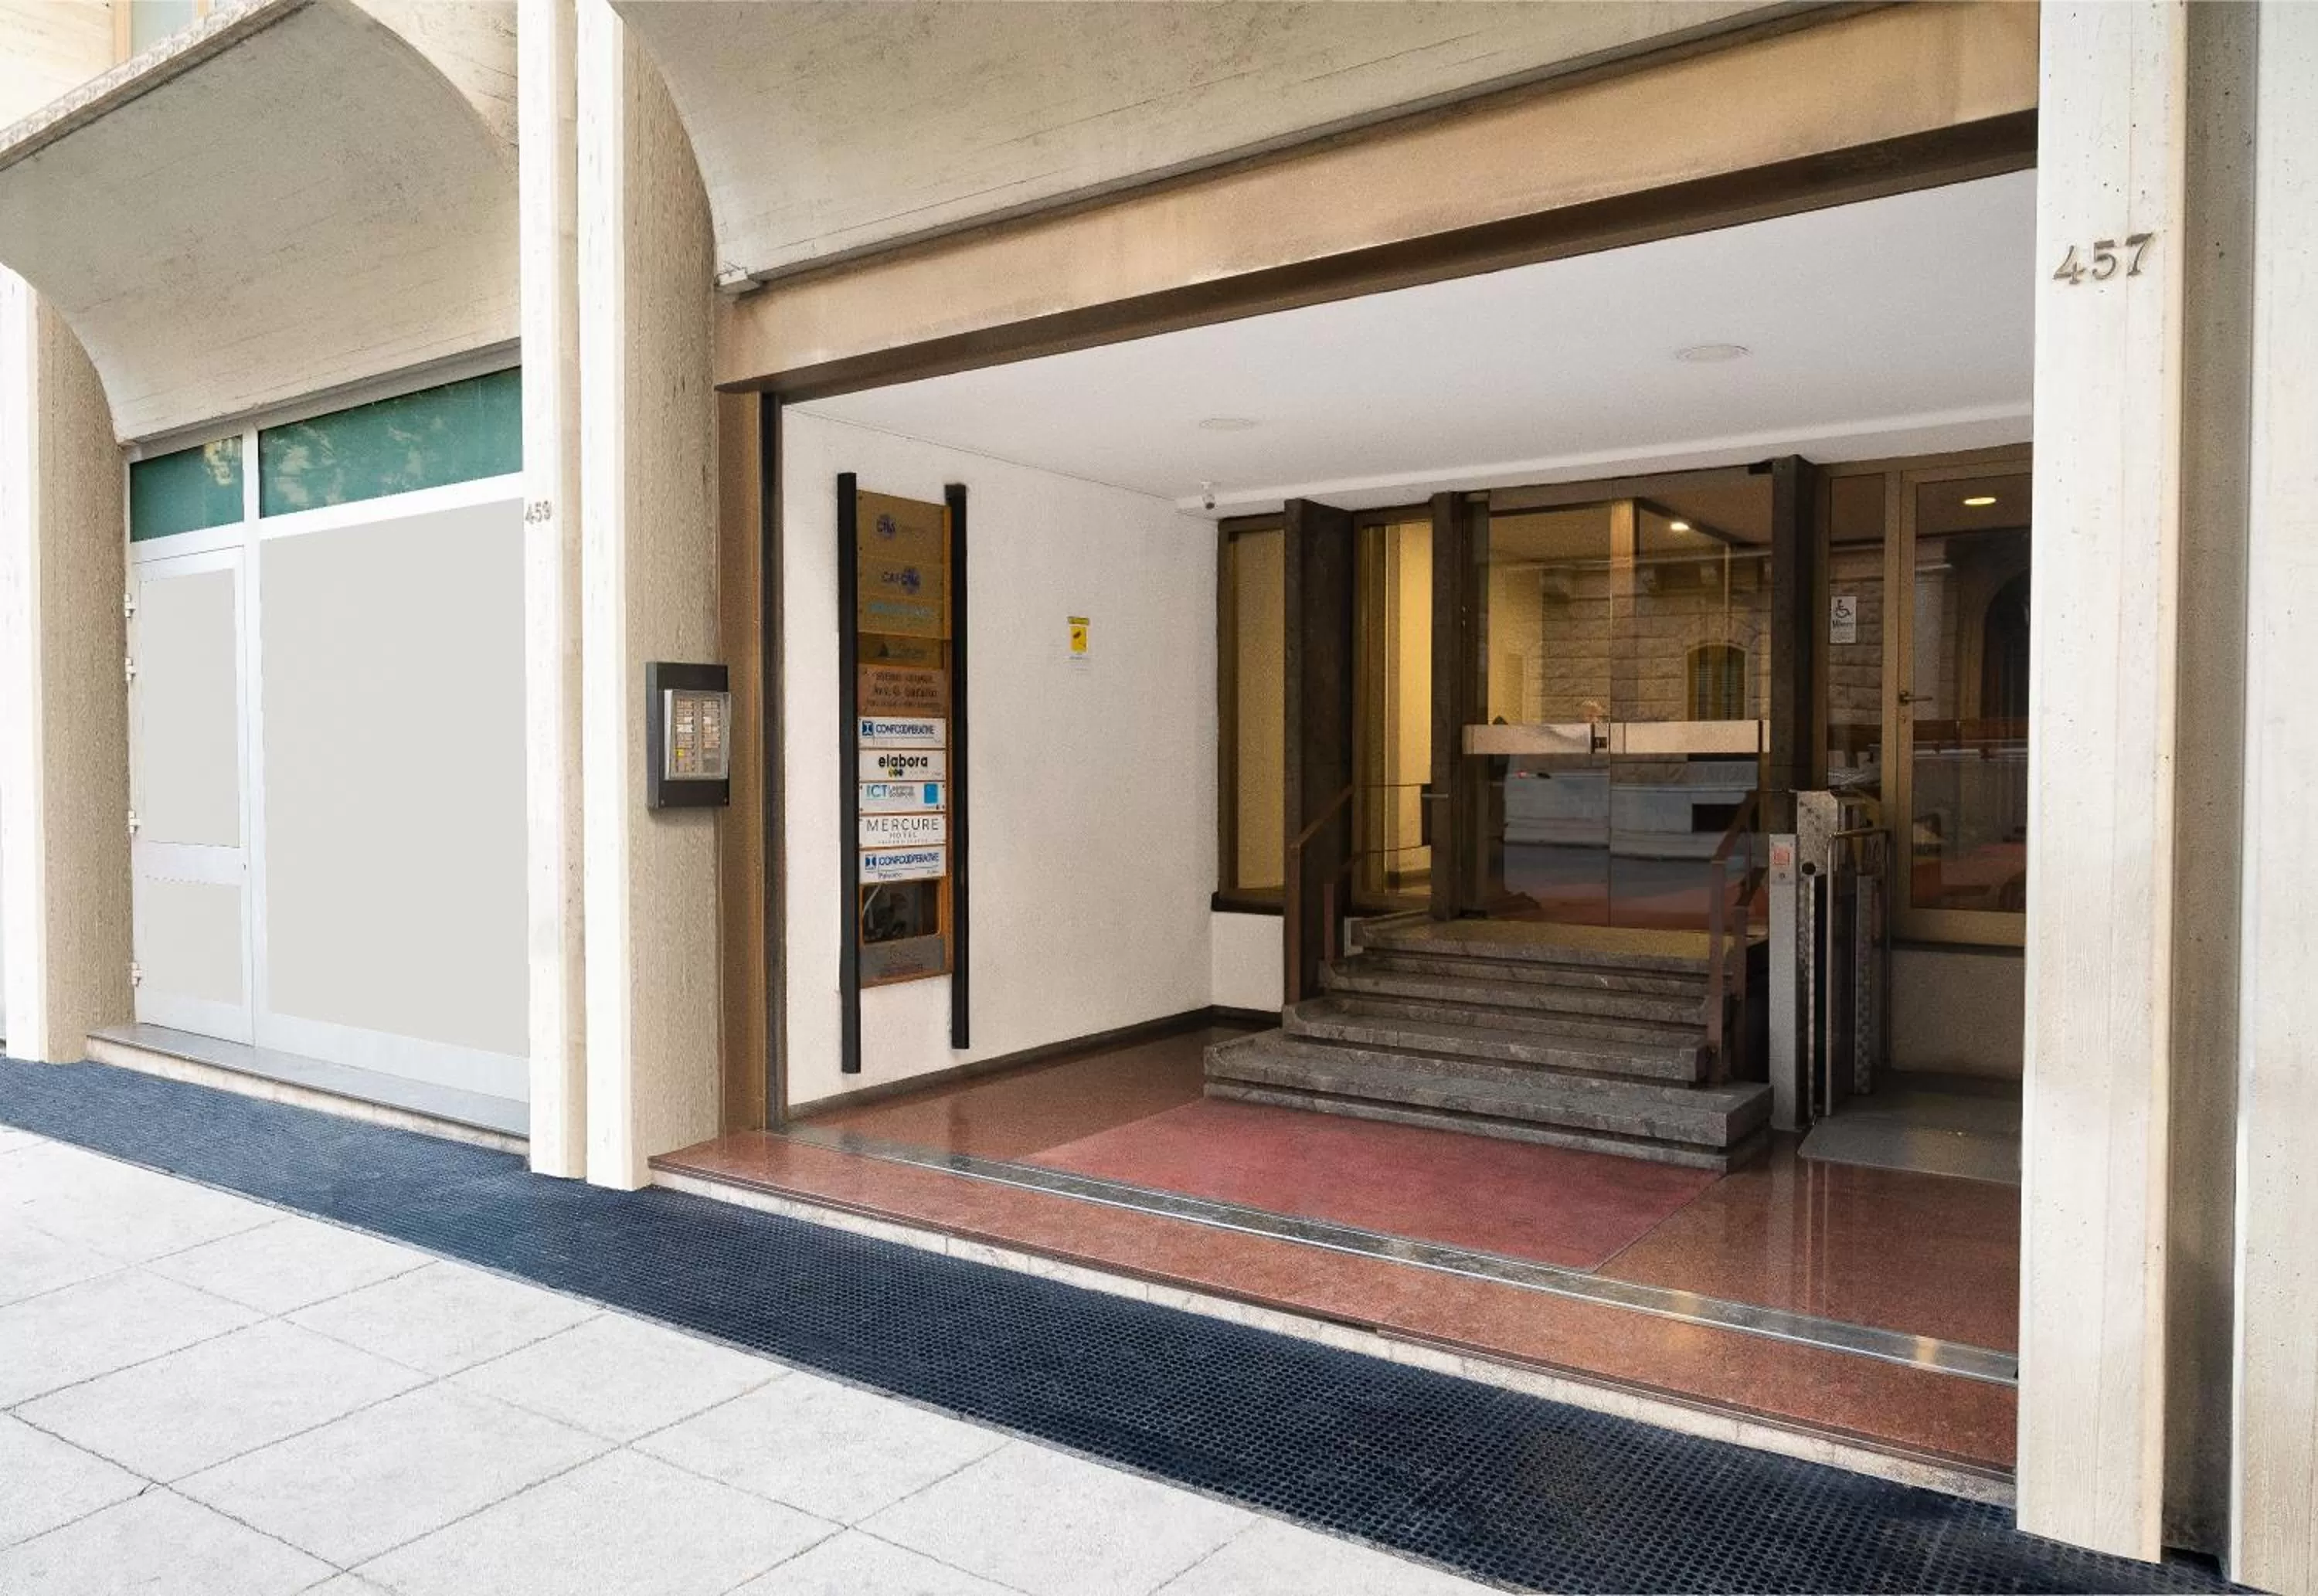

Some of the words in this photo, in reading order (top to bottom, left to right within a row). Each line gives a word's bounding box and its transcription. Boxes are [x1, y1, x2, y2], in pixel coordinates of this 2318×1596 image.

[2053, 232, 2153, 285] 457
[878, 753, 929, 768] elabora
[866, 784, 888, 798] ICT
[866, 818, 940, 832] MERCURE
